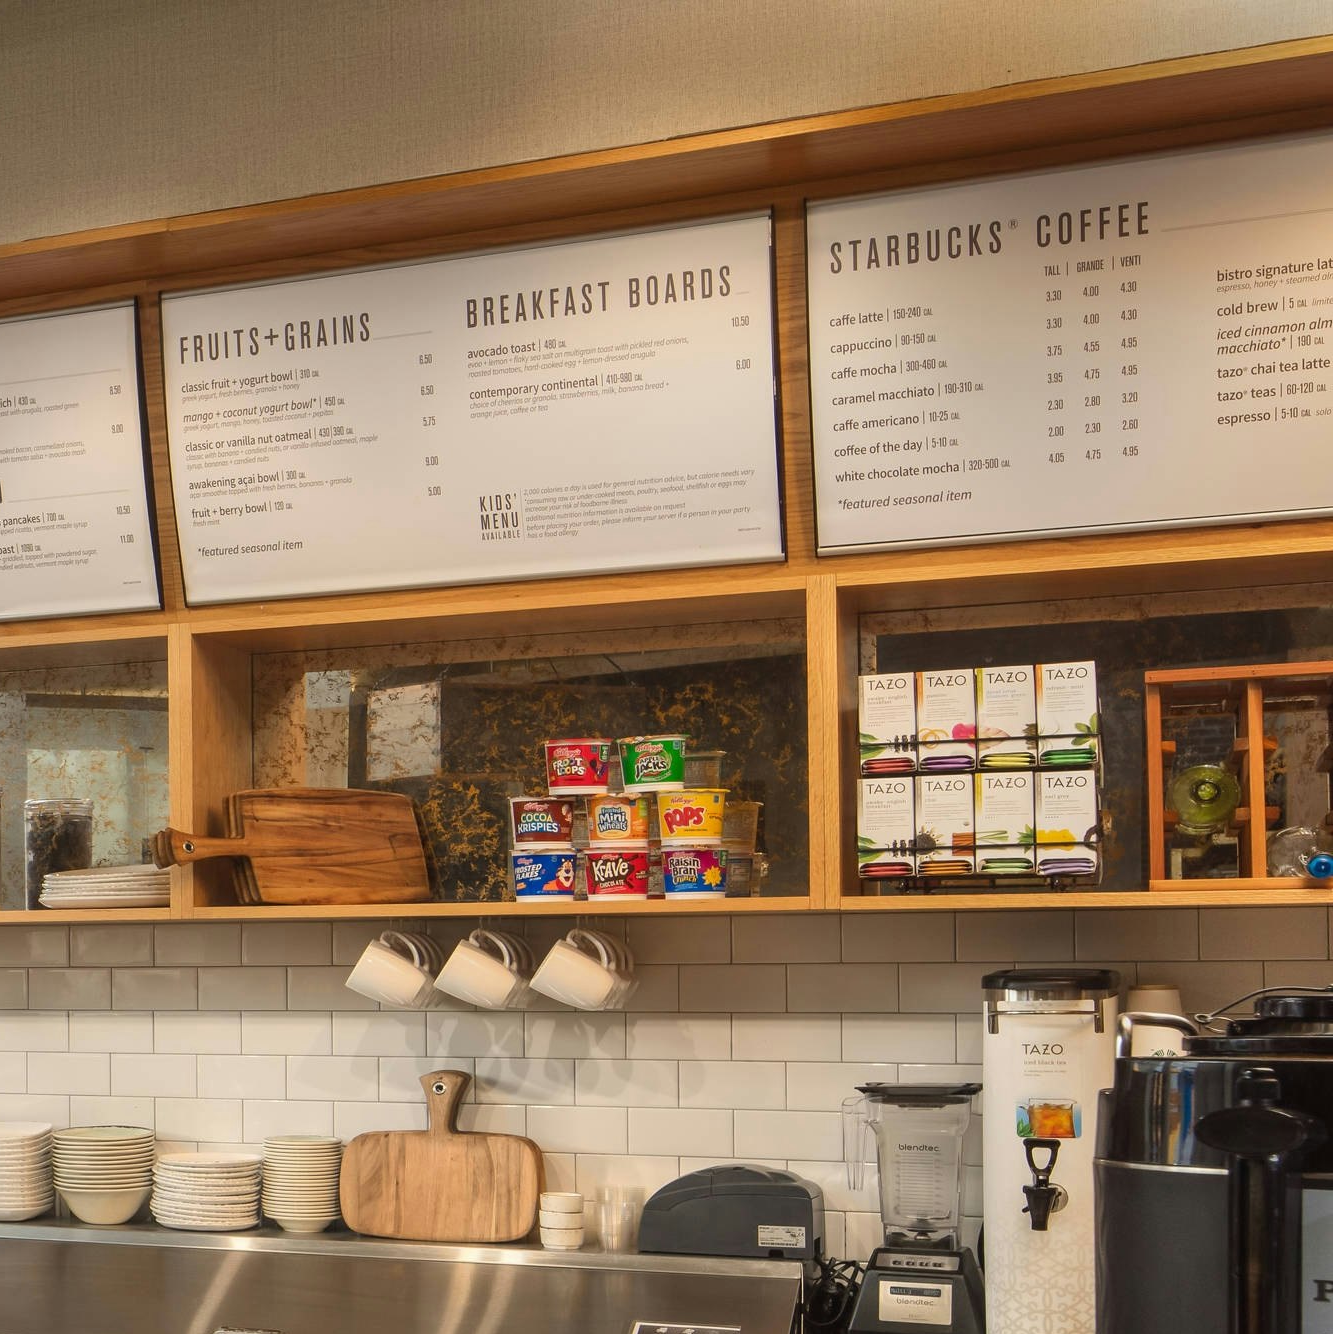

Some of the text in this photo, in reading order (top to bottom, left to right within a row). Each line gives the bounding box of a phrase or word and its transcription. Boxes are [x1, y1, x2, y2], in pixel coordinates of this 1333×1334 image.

[1036, 201, 1149, 248] COFFEE
[1044, 255, 1141, 277] TALL GRANDE VENTI
[1217, 261, 1314, 281] bistro signature
[466, 265, 731, 329] BREAKFAST BOARDS
[1046, 281, 1137, 302] 3.30 4.00 4.30
[829, 306, 921, 327] caffe latte 150-240
[1216, 300, 1278, 316] cold brew
[731, 315, 750, 328] 10.50
[1217, 323, 1306, 340] iced cinnamon
[467, 341, 536, 358] avocado toast
[830, 333, 925, 355] cappuccino 90-150
[831, 363, 897, 379] caffe mocha
[1250, 358, 1331, 375] chai tea latte
[181, 380, 210, 393] classic
[211, 377, 230, 389] fruit
[239, 373, 269, 389] yogurt
[270, 369, 293, 383] bowl
[469, 385, 539, 399] contemporary
[541, 375, 598, 392] continental
[832, 386, 935, 405] caramel macchiato
[1250, 382, 1314, 398] teas 60-120
[183, 412, 214, 423] mango
[222, 404, 258, 418] coconut
[259, 400, 289, 417] yogurt
[1217, 411, 1271, 427] espresso
[833, 416, 920, 431] caffe americano
[185, 428, 312, 452] classic or vanilla nut oatmeal
[834, 440, 923, 457] coffee of the day
[189, 477, 237, 490] awakening
[257, 471, 280, 483] bowl
[835, 462, 960, 482] white chocolate mocha
[479, 493, 517, 512] KIDS'
[892, 491, 944, 505] seasonal
[946, 491, 972, 501] item
[3, 514, 41, 529] pancakes
[480, 511, 519, 530] MENU
[481, 529, 521, 541] AVAILABLE
[1046, 668, 1088, 680] TAZO
[867, 678, 906, 690] TAZO
[866, 783, 906, 794] TAZO
[521, 813, 553, 823] COCOA
[599, 813, 627, 823] Mini
[663, 807, 706, 835] POPS
[518, 823, 558, 834] KRISPIES
[669, 857, 701, 868] Raisin
[672, 866, 697, 877] Bran
[1022, 1044, 1063, 1055] TAZO
